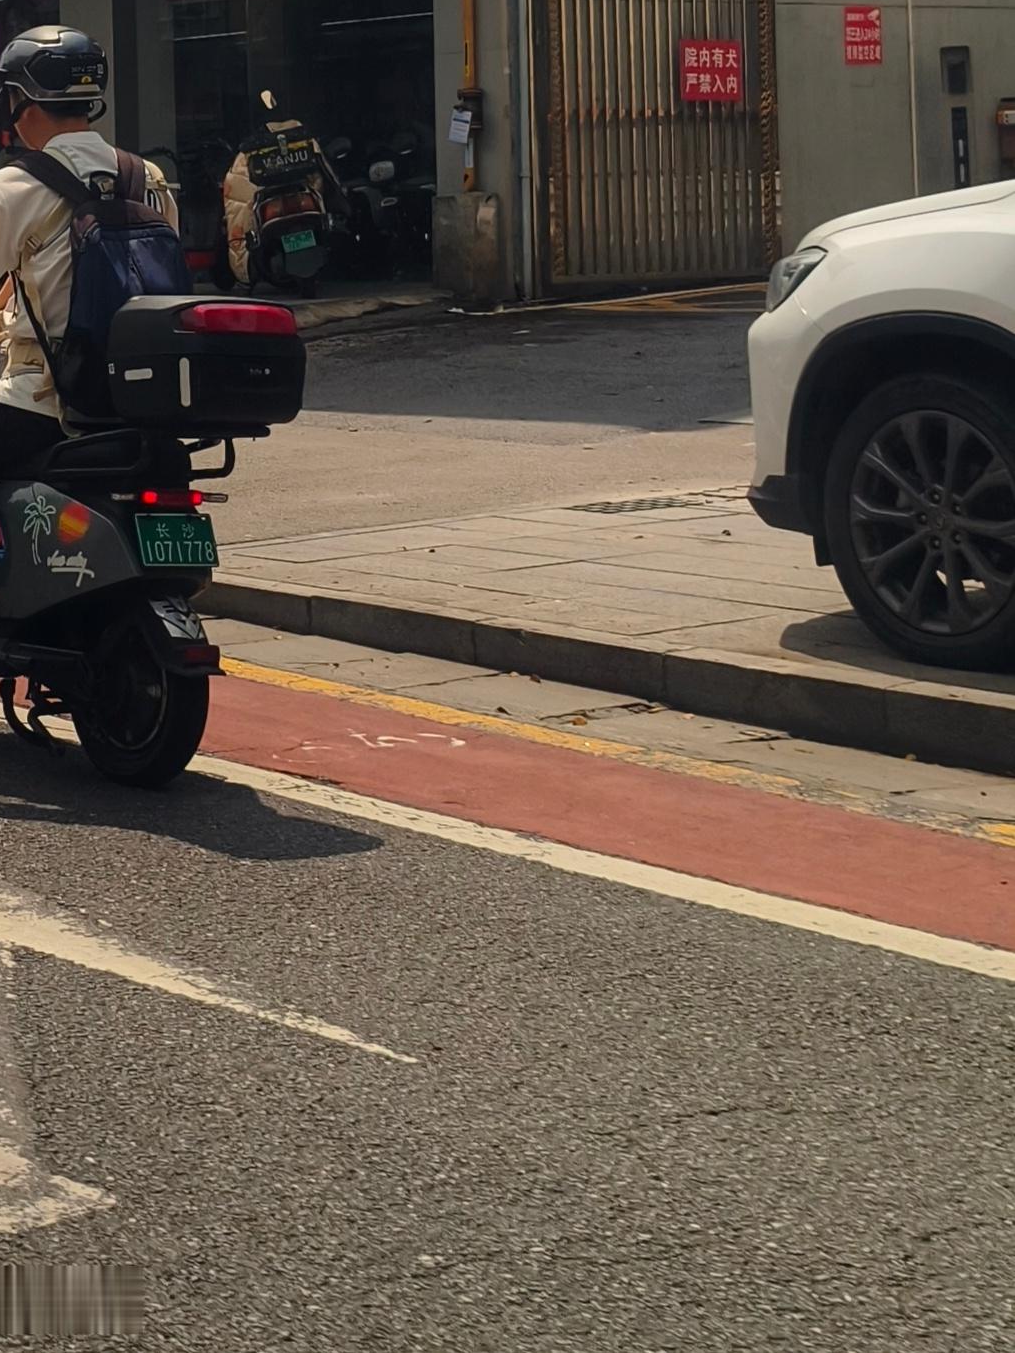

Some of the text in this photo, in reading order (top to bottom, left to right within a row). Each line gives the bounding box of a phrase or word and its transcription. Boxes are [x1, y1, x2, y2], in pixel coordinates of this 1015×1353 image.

[685, 47, 737, 68] 院内有犬
[685, 73, 737, 94] 严禁入内
[156, 522, 195, 539] 长沙
[146, 540, 215, 563] 1071778
